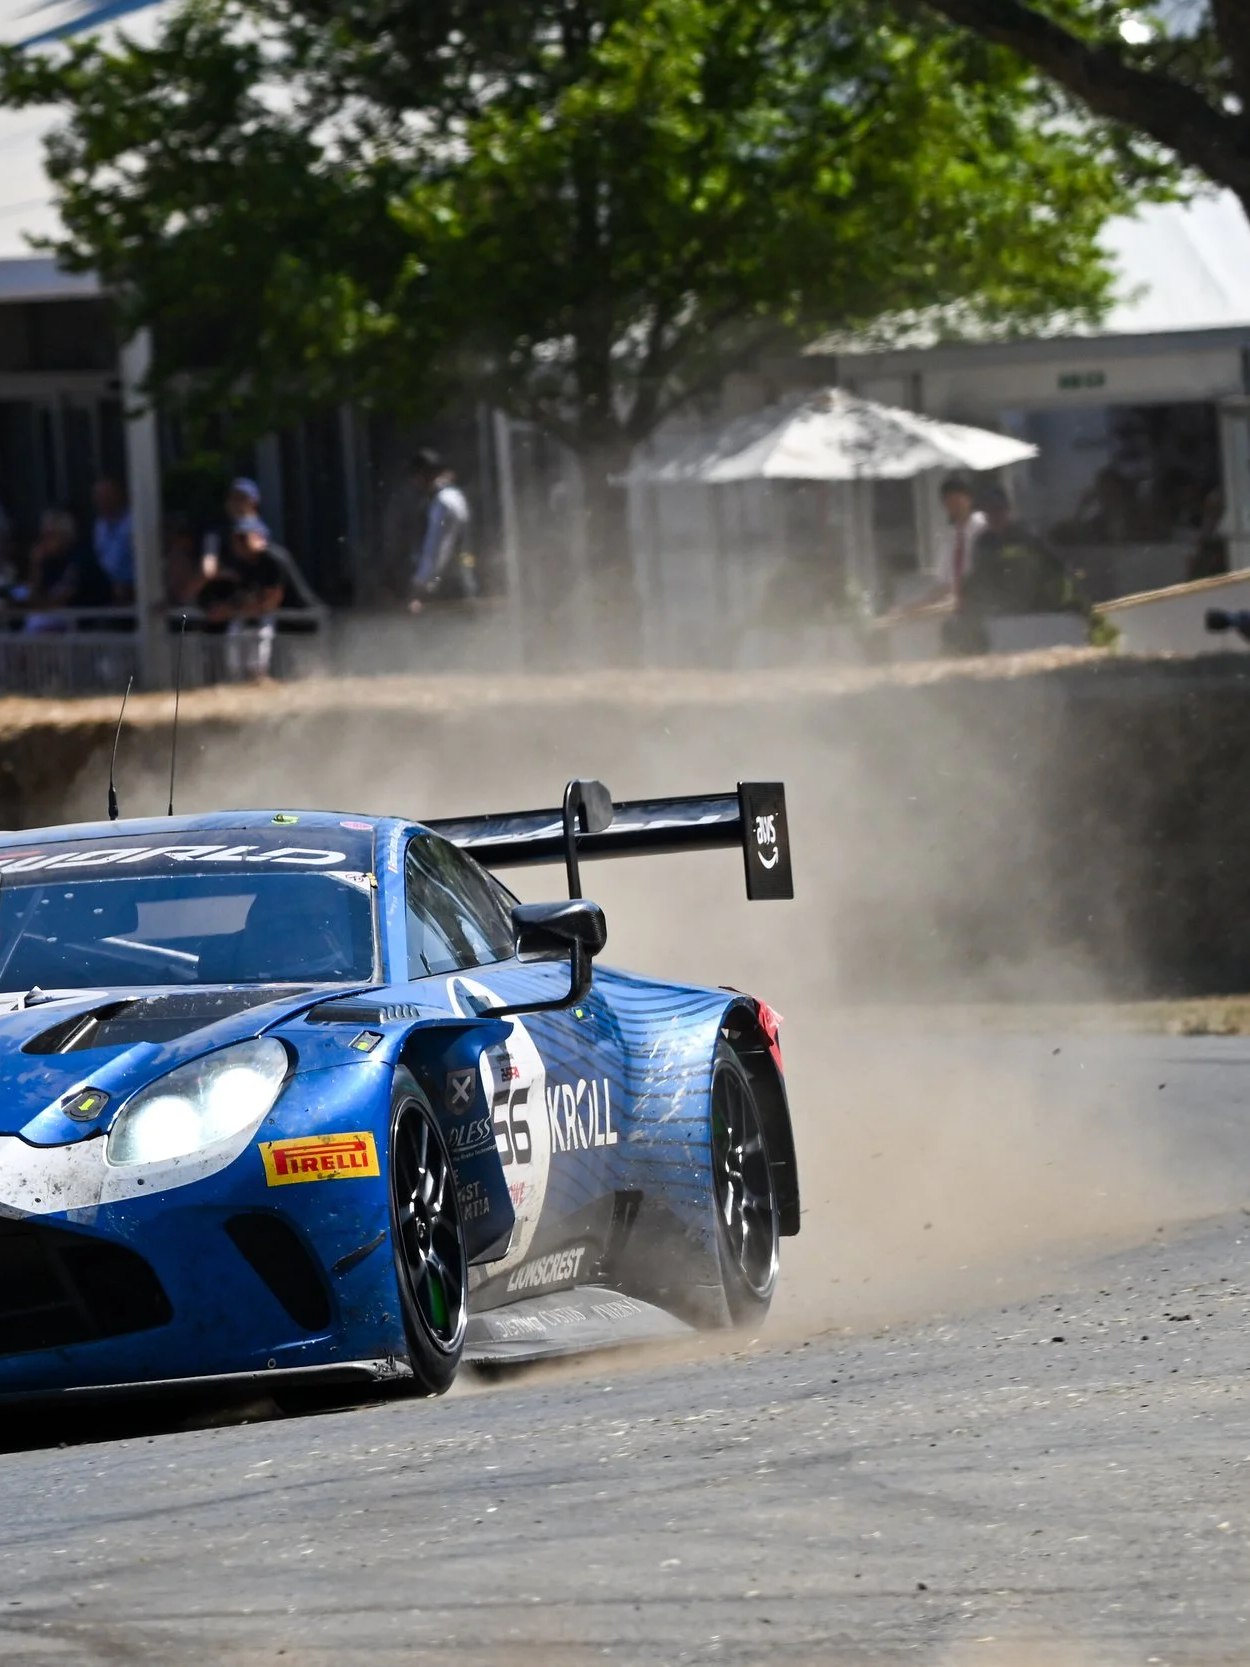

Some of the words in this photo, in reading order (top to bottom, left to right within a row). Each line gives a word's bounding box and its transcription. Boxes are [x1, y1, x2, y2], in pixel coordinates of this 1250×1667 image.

[755, 814, 776, 845] aws
[448, 1114, 491, 1146] DLESS
[491, 1087, 532, 1166] 56
[547, 1078, 618, 1153] KROLL
[272, 1141, 369, 1175] PIRELLI
[506, 1247, 586, 1292] LIONSCREST
